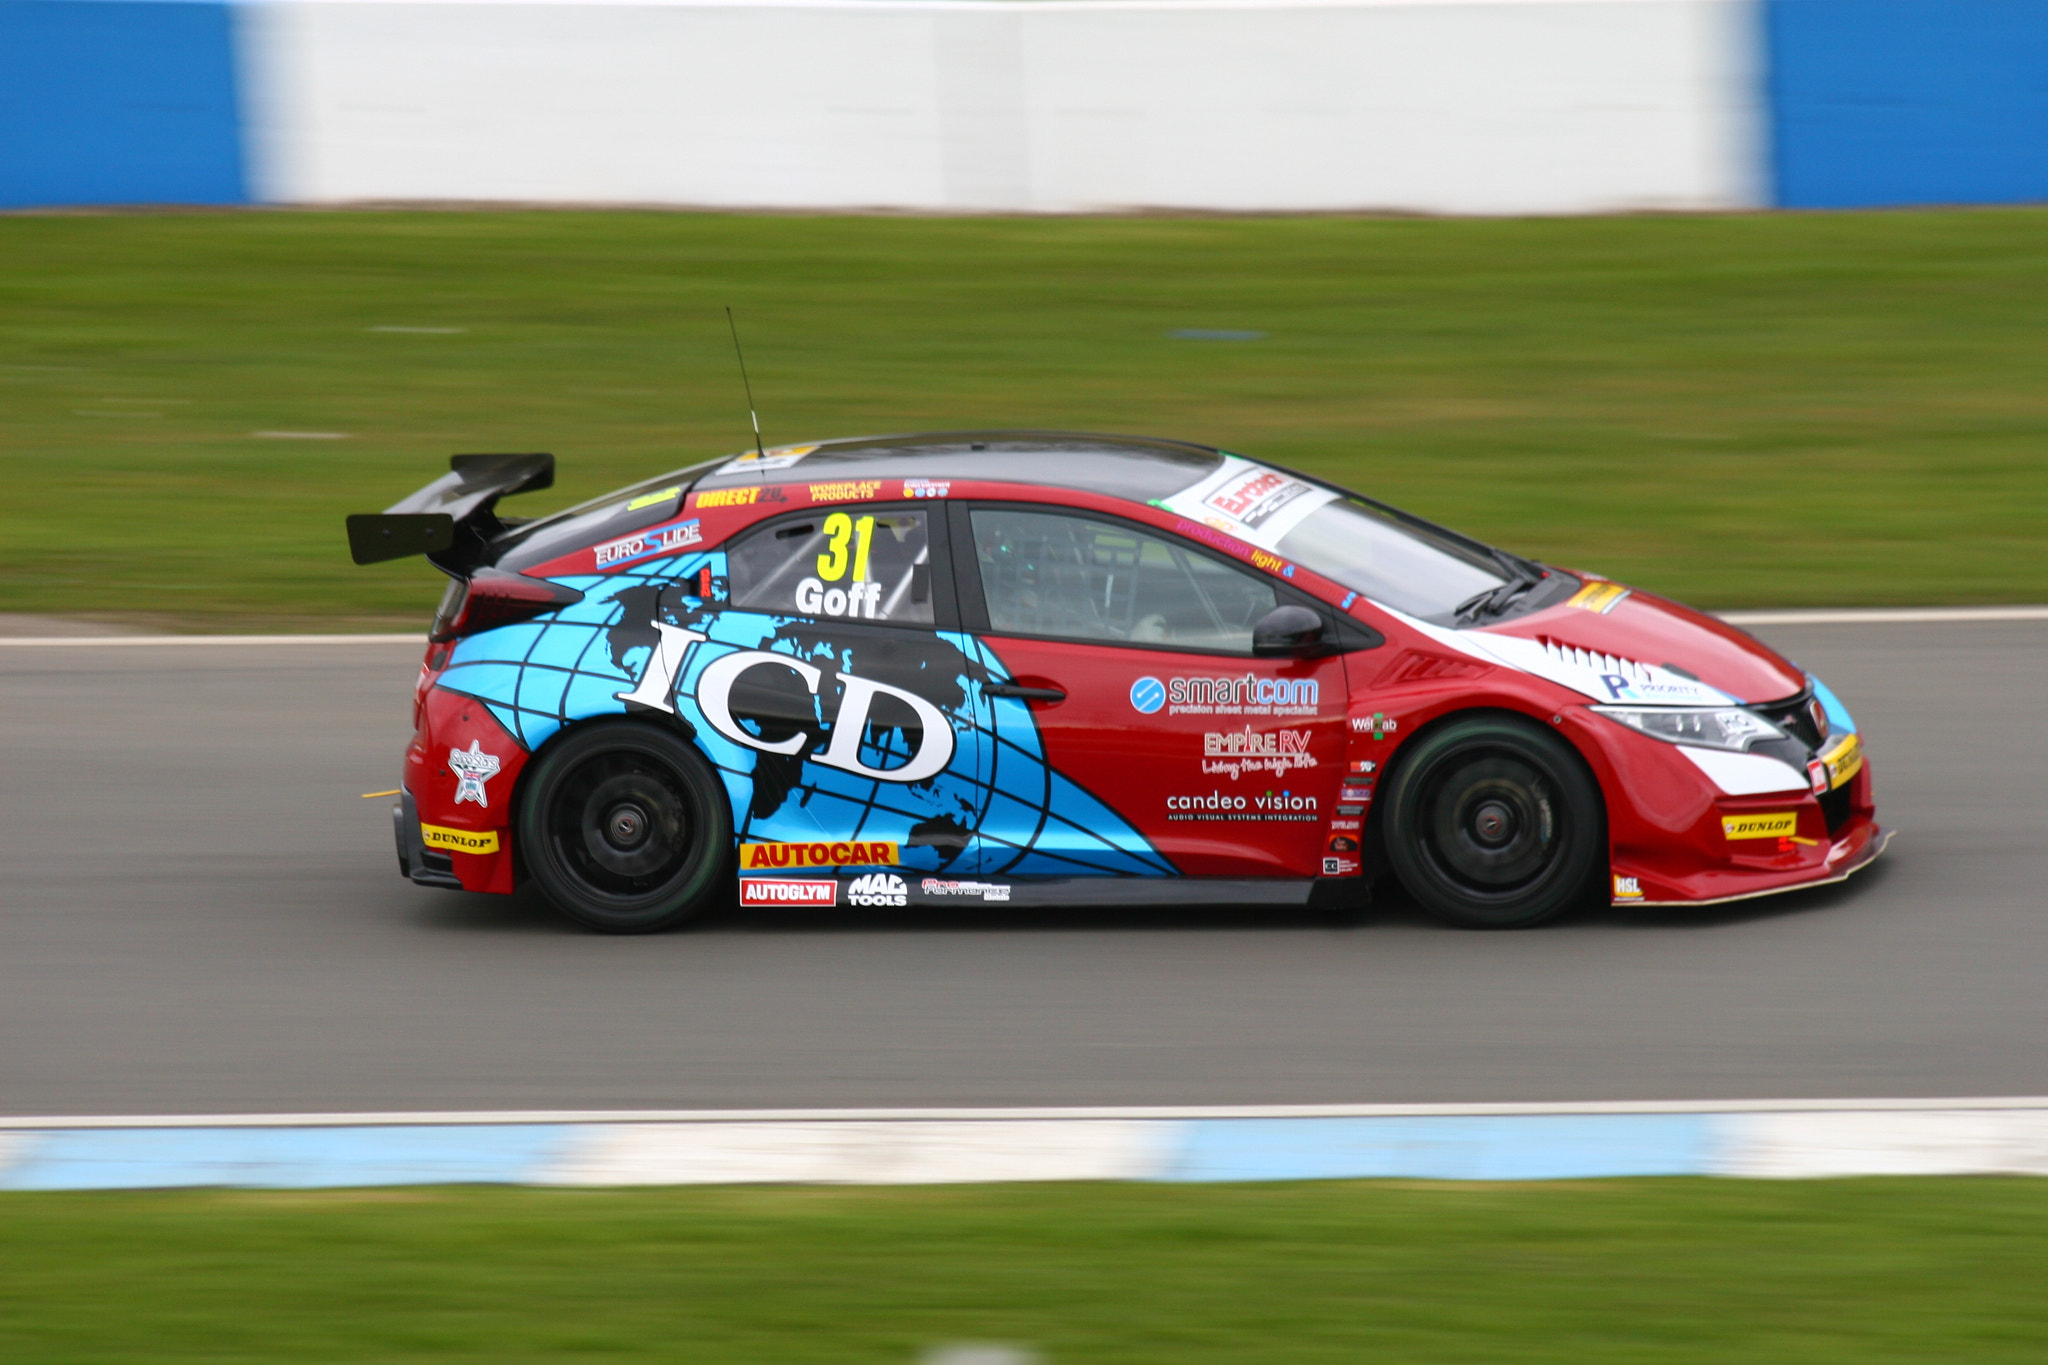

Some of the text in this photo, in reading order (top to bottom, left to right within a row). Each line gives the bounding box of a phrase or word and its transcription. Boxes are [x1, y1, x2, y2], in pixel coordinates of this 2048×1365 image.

[808, 480, 882, 494] WORKPLACE
[811, 490, 876, 502] PRODUCTS
[816, 512, 875, 582] 31
[1176, 518, 1250, 557] production
[1251, 550, 1283, 573] light
[795, 577, 882, 619] Goff
[1169, 673, 1319, 705] smartcom
[617, 619, 954, 782] ICD
[1169, 704, 1318, 717] precision sheet metal specialist
[1204, 724, 1312, 753] EMPIRE RV
[1241, 757, 1263, 772] the
[1264, 757, 1293, 778] high
[1293, 752, 1318, 769] life
[1167, 789, 1246, 810] candeo
[1254, 789, 1318, 810] vision
[1168, 813, 1318, 822] AUDIO VISUAL SYSTEMS INTEGRATION
[1736, 820, 1792, 833] DUNLOP
[431, 831, 492, 849] DUNLOP
[750, 842, 891, 868] AUTOCAR
[745, 883, 831, 901] AUTOGLYM
[1616, 876, 1642, 893] HSL
[848, 894, 908, 907] TOOLS
